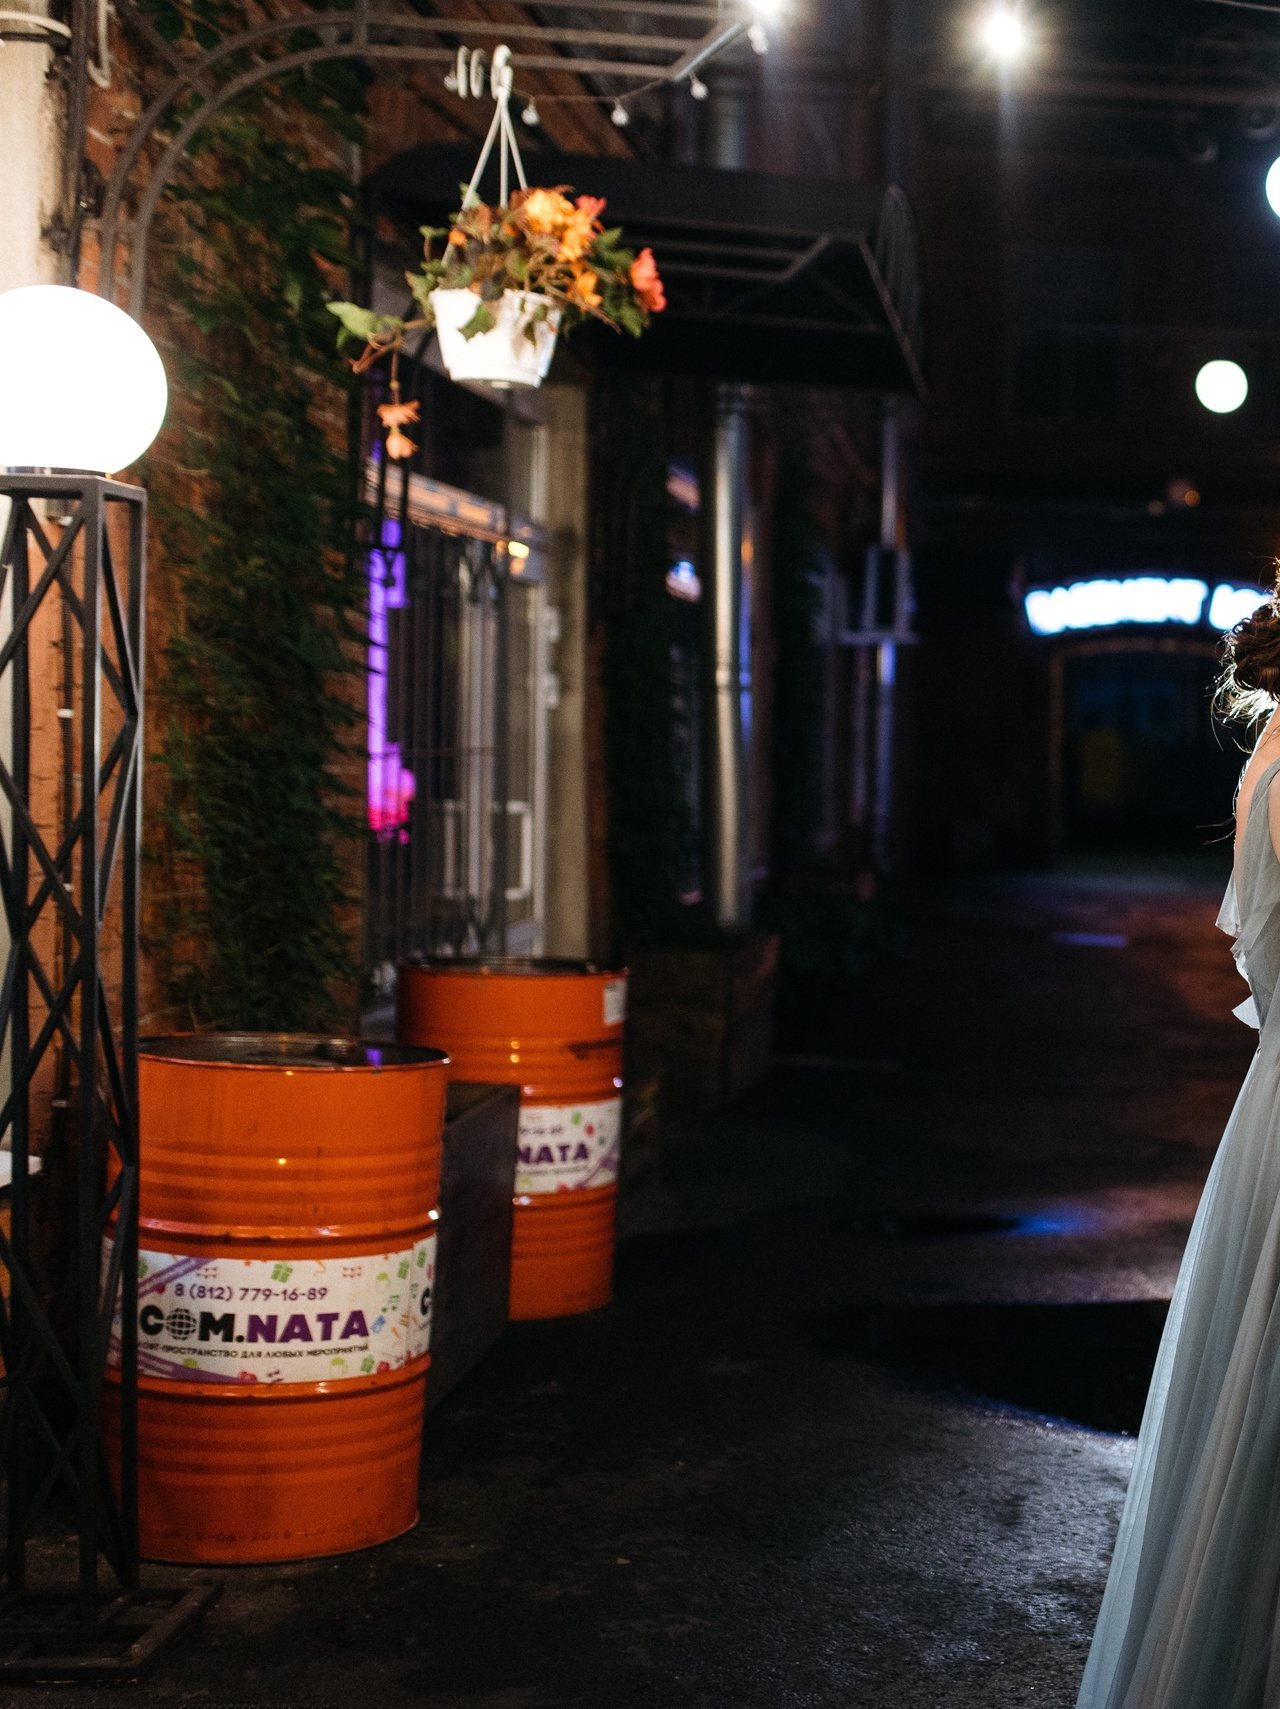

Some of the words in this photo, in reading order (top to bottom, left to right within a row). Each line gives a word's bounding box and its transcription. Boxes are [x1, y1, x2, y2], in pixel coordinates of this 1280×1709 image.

[174, 1283, 184, 1297] 8
[189, 1283, 233, 1302] (812)
[239, 1287, 328, 1301] 779-16-89
[241, 1346, 262, 1359] ДЛЯ
